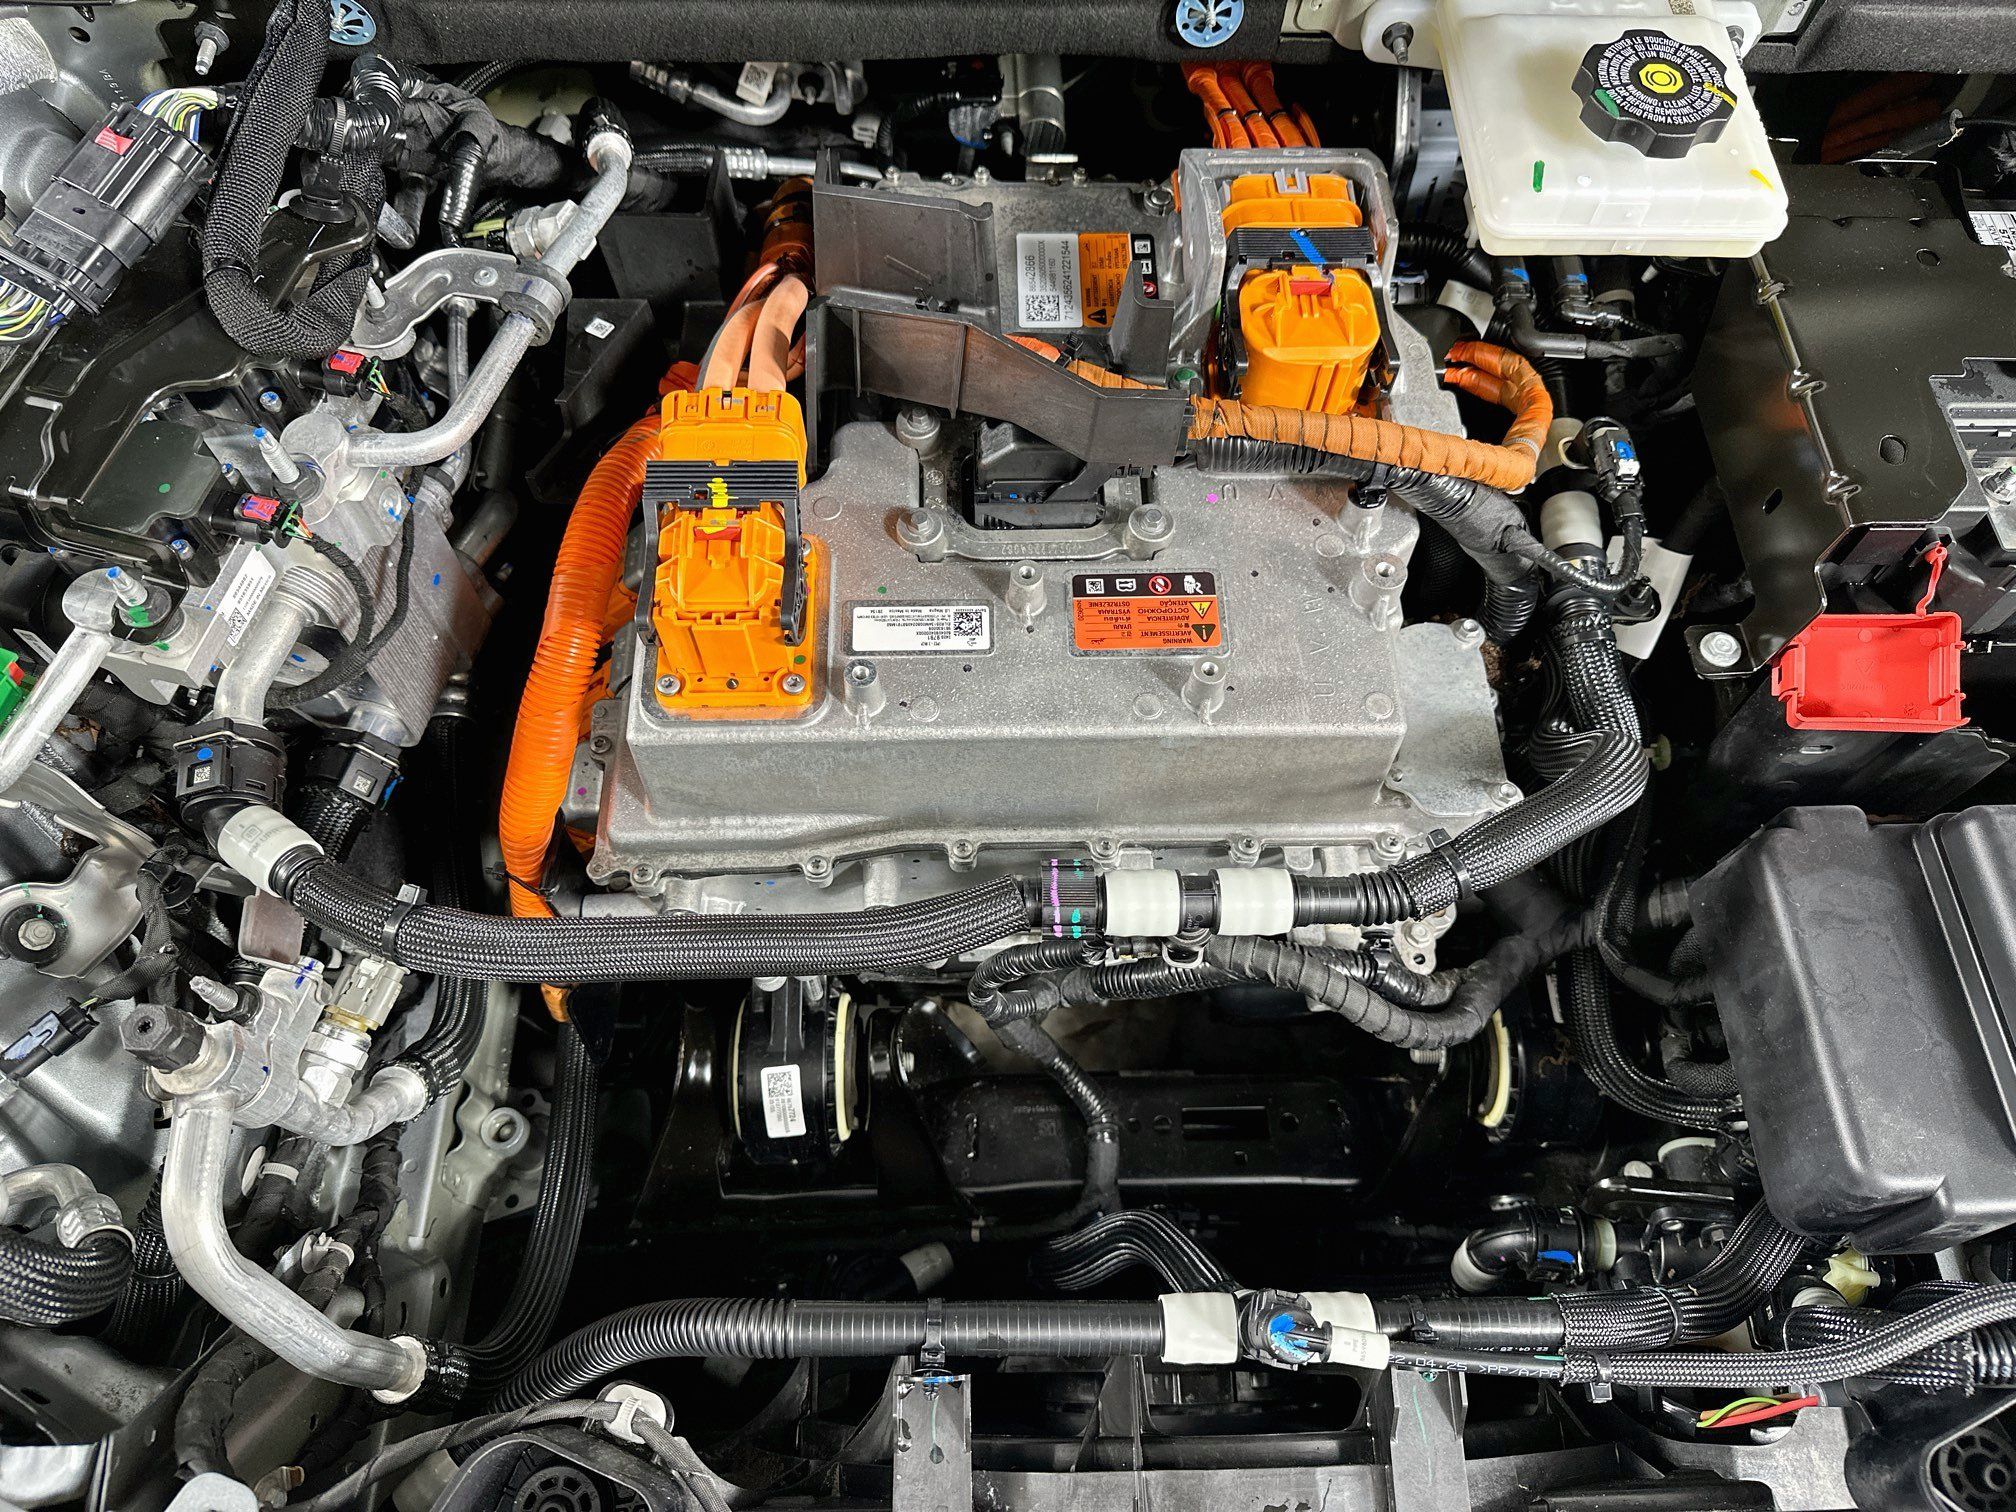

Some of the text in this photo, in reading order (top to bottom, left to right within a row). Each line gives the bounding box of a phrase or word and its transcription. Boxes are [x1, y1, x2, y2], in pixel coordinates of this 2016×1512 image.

[1603, 38, 1633, 59] NETTOYER
[1632, 36, 1643, 44] LE
[1644, 36, 1680, 48] BOUCHON
[1679, 45, 1704, 60] AVANT
[1701, 58, 1712, 68] LA
[1707, 66, 1724, 88] DEPOSE
[1620, 46, 1636, 57] QUE
[1634, 44, 1646, 52] DU
[1647, 43, 1676, 55] LIQUIDE
[1676, 50, 1688, 59] DE
[1686, 56, 1706, 73] FREIN
[1638, 51, 1657, 59] D'UN
[1659, 51, 1683, 65] BIDON
[1681, 62, 1702, 84] SCELLE
[1615, 86, 1630, 97] CAP
[1625, 95, 1655, 113] BEFORE
[1692, 99, 1707, 110] USE
[1625, 84, 1703, 109] WARNING: CLEAN FILLER
[1619, 101, 1643, 117] FLUID
[1642, 111, 1666, 124] FROM
[1672, 113, 1702, 125] SEALED
[1987, 225, 1998, 236] 12V
[1999, 228, 2016, 251] 5772
[1137, 607, 1190, 615] ОСТОРОЖНО
[1146, 614, 1190, 622] ADVERTENCIA
[1140, 629, 1192, 637] AVERTISSEMENT
